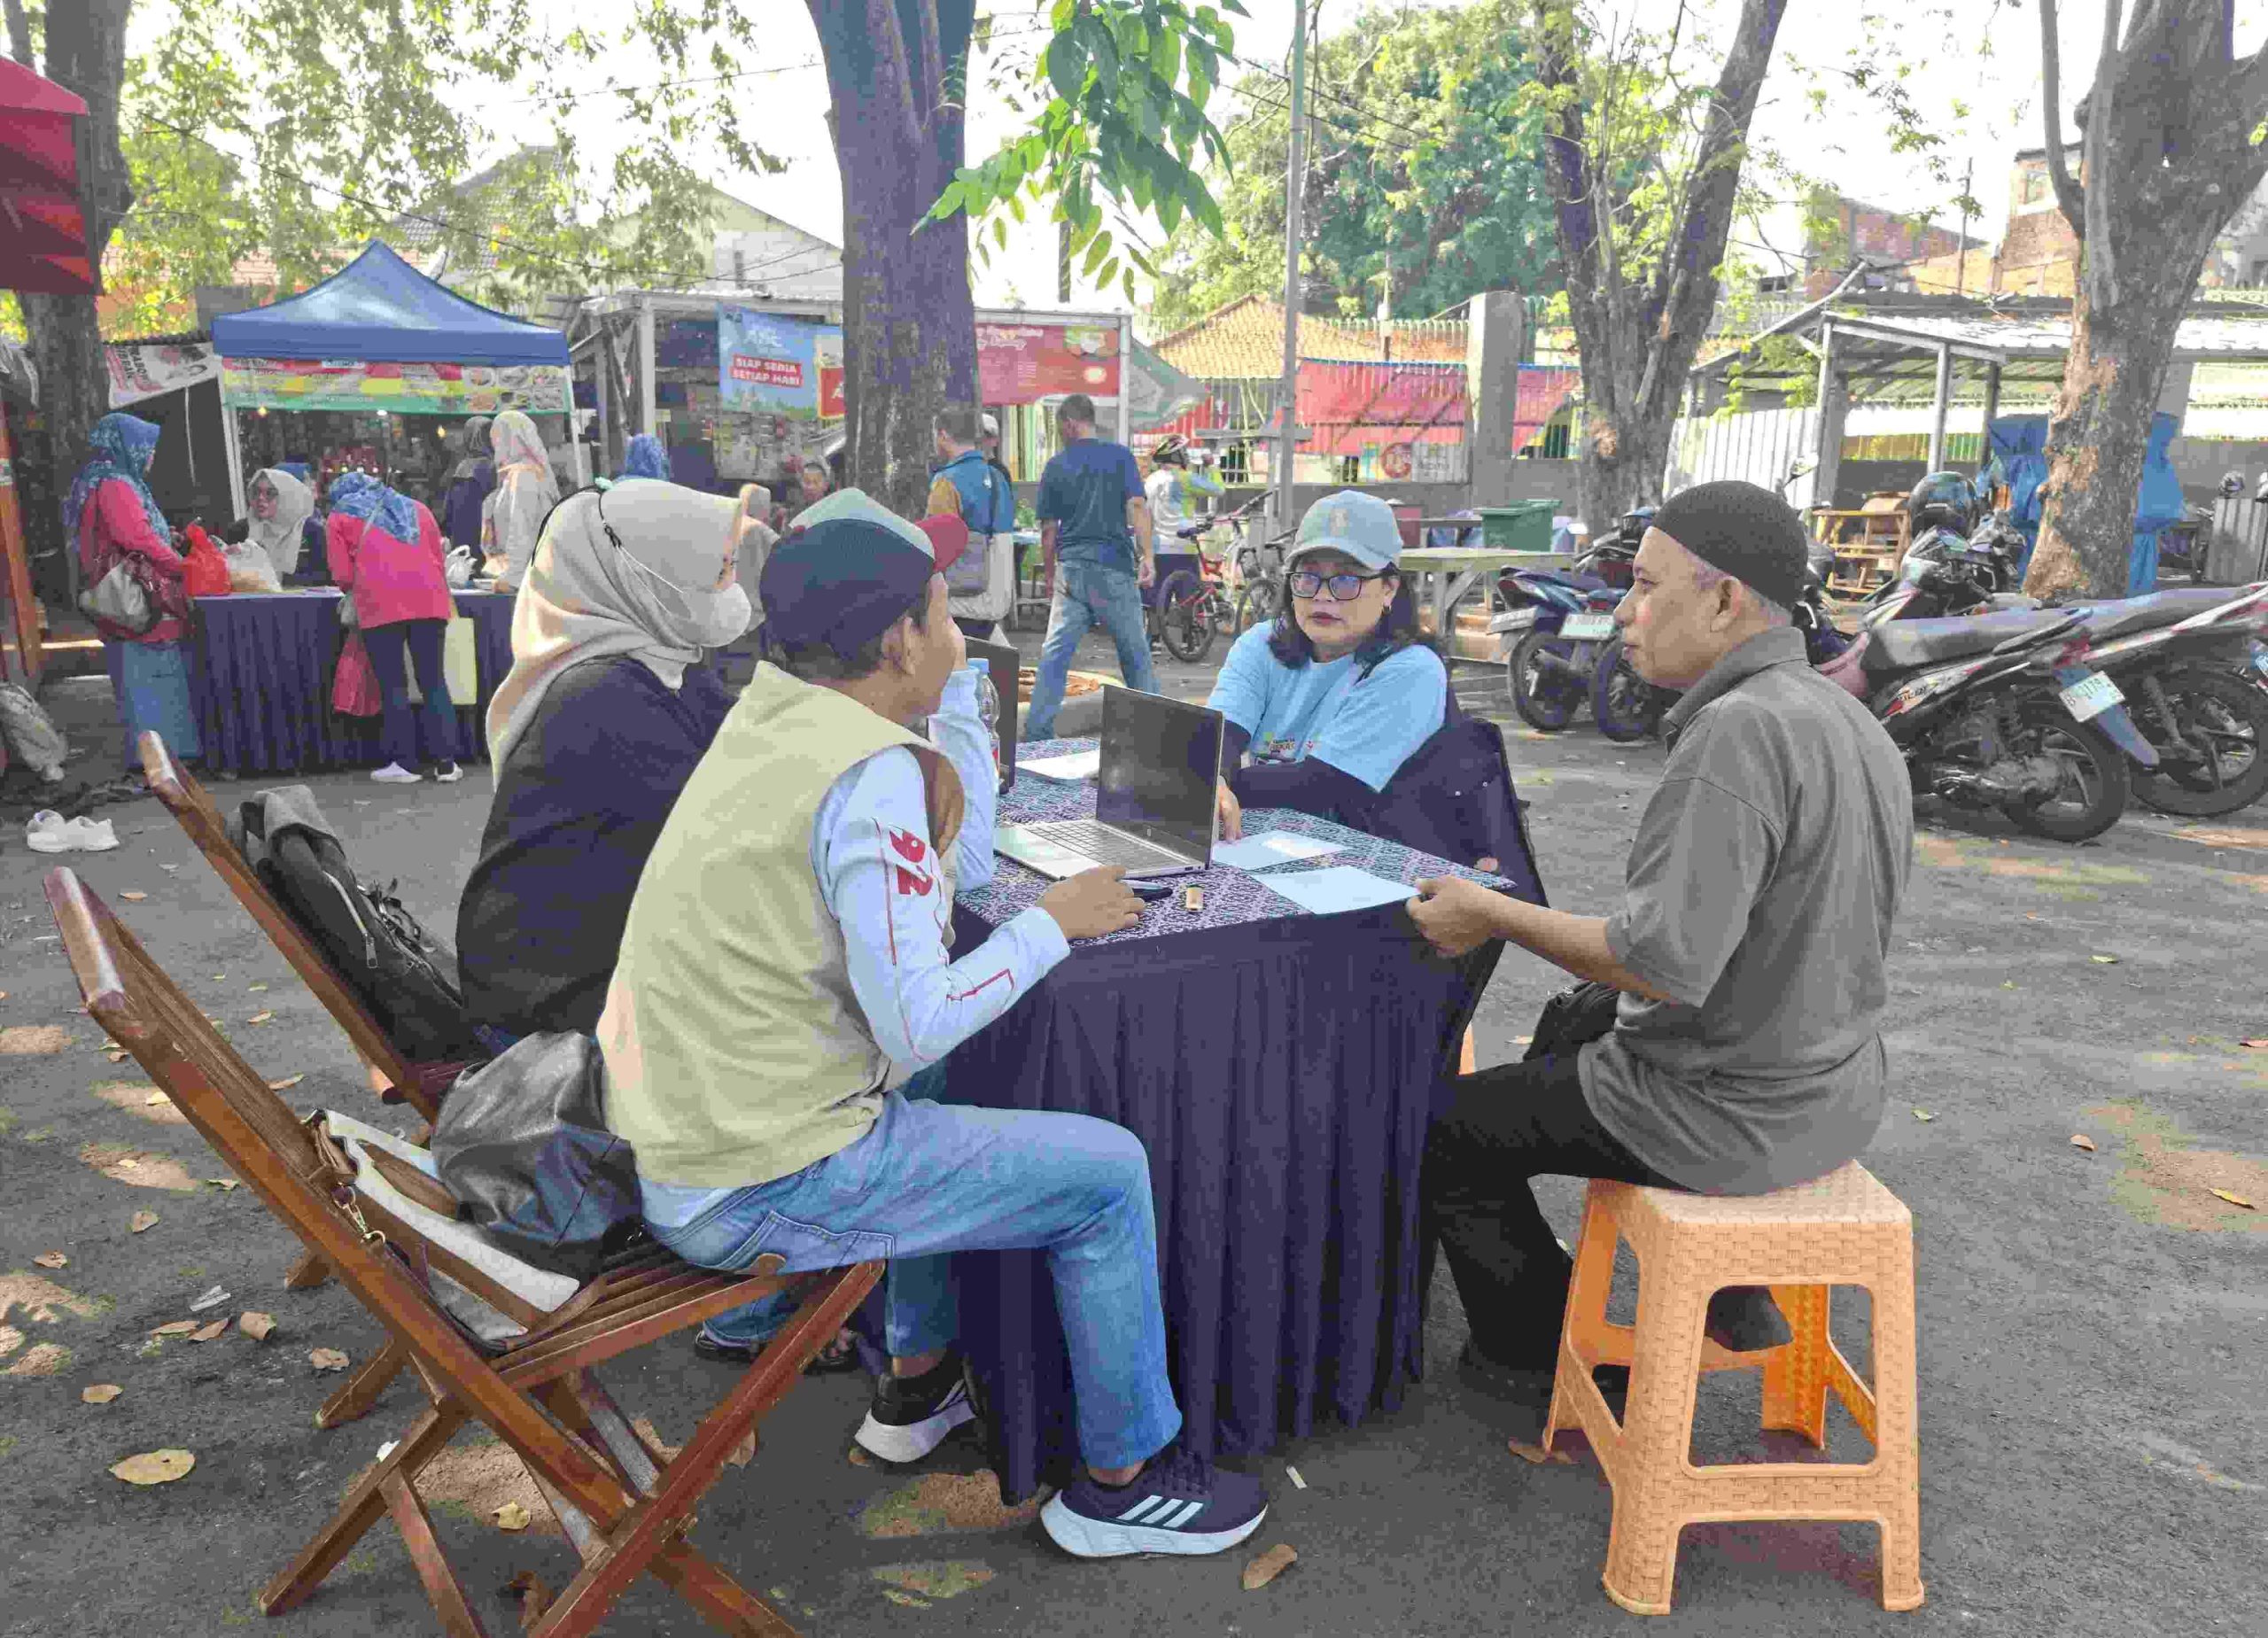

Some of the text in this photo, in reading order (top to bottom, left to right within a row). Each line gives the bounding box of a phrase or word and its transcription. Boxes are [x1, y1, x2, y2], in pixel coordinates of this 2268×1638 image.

[736, 358, 796, 373] SIAP SEDIA
[732, 369, 800, 385] SETIAP HARI
